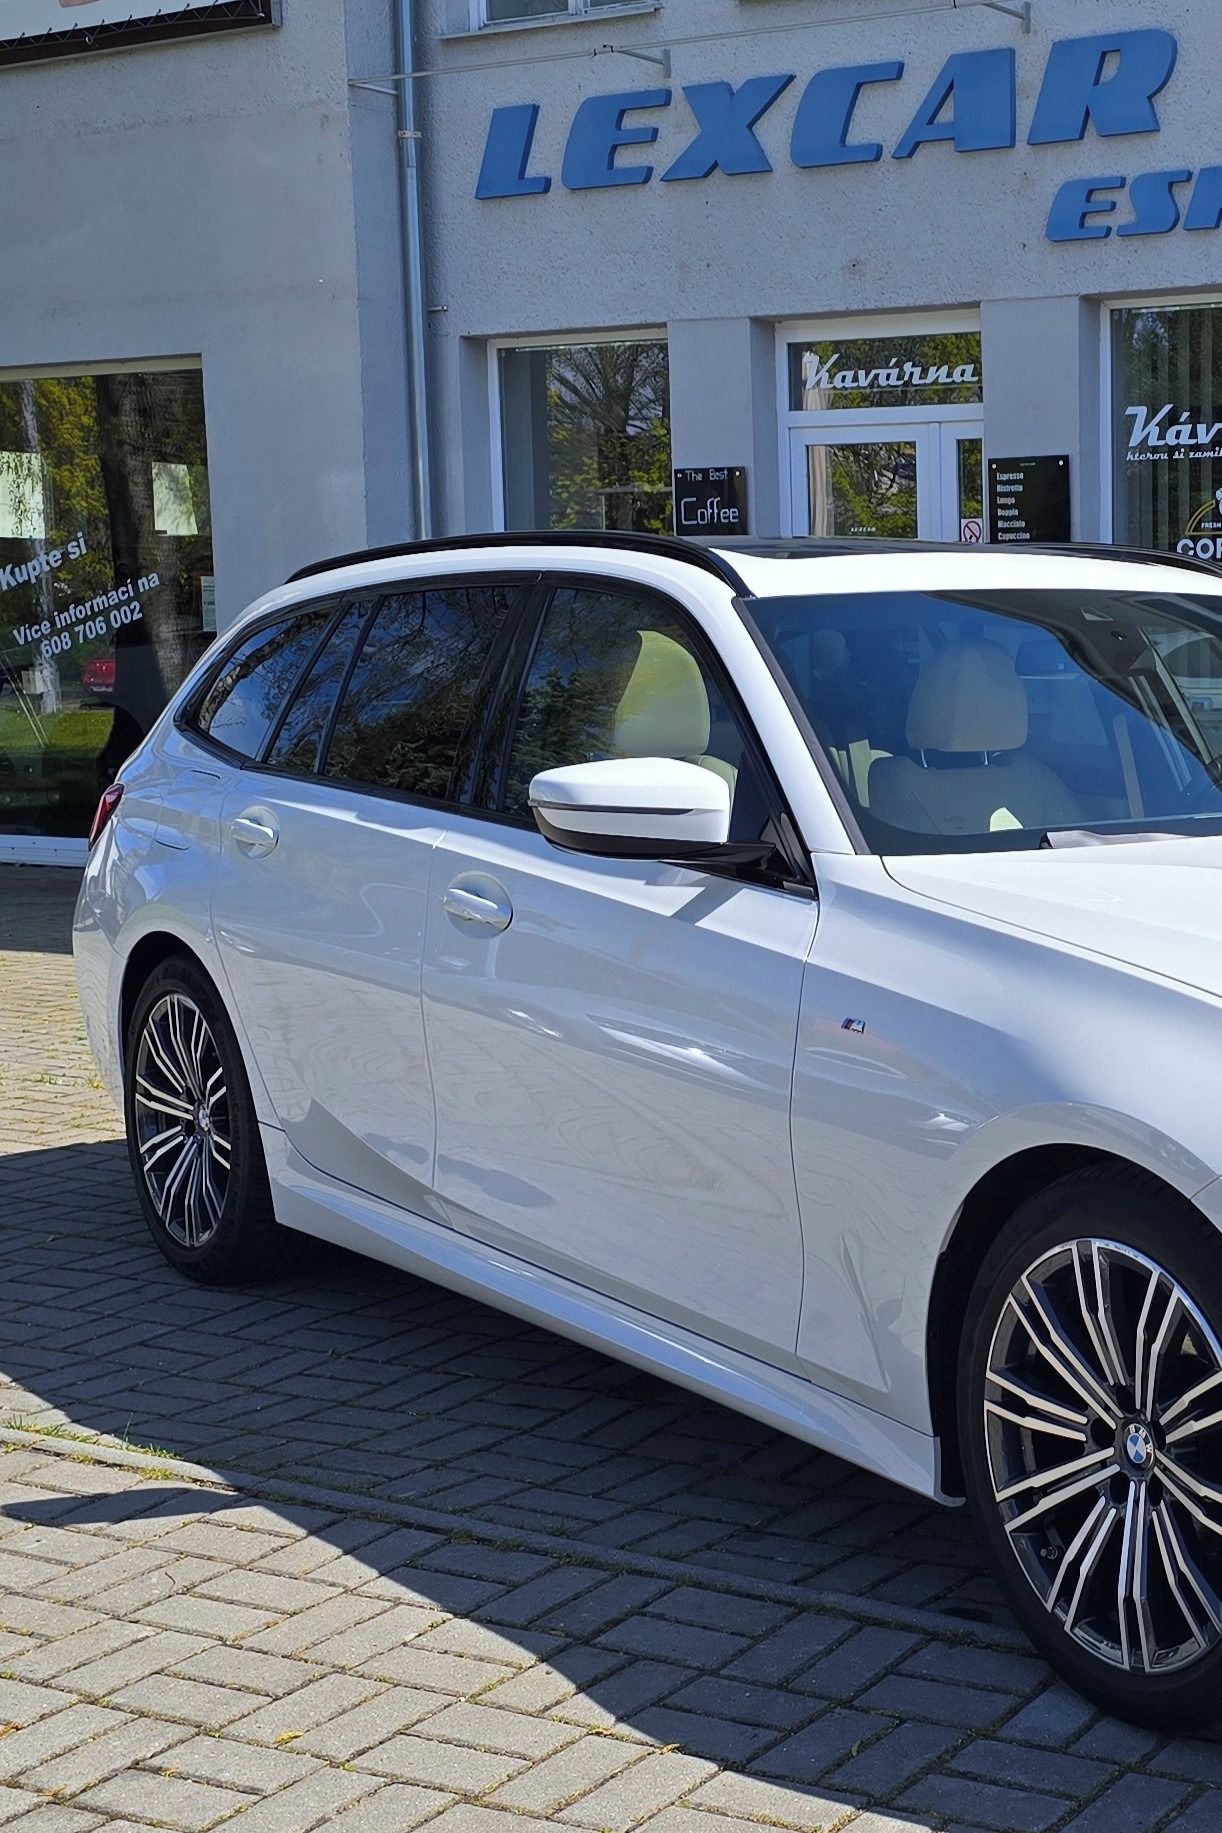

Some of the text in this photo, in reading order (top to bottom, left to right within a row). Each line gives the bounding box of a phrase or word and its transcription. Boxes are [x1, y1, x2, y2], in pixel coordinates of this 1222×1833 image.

[474, 28, 1178, 200] LEXCAR
[805, 352, 979, 389] Kavárna
[1126, 450, 1168, 461] kterou
[1173, 448, 1185, 459] si
[685, 468, 728, 482] The Best
[997, 472, 1024, 481] Espresso
[681, 497, 739, 524] Coffee
[997, 496, 1016, 505] Lungo
[0, 531, 87, 591] Kupte si
[13, 572, 160, 646] Více informací na
[41, 601, 142, 658] 608 706 002
[1129, 1424, 1153, 1453] BMW
